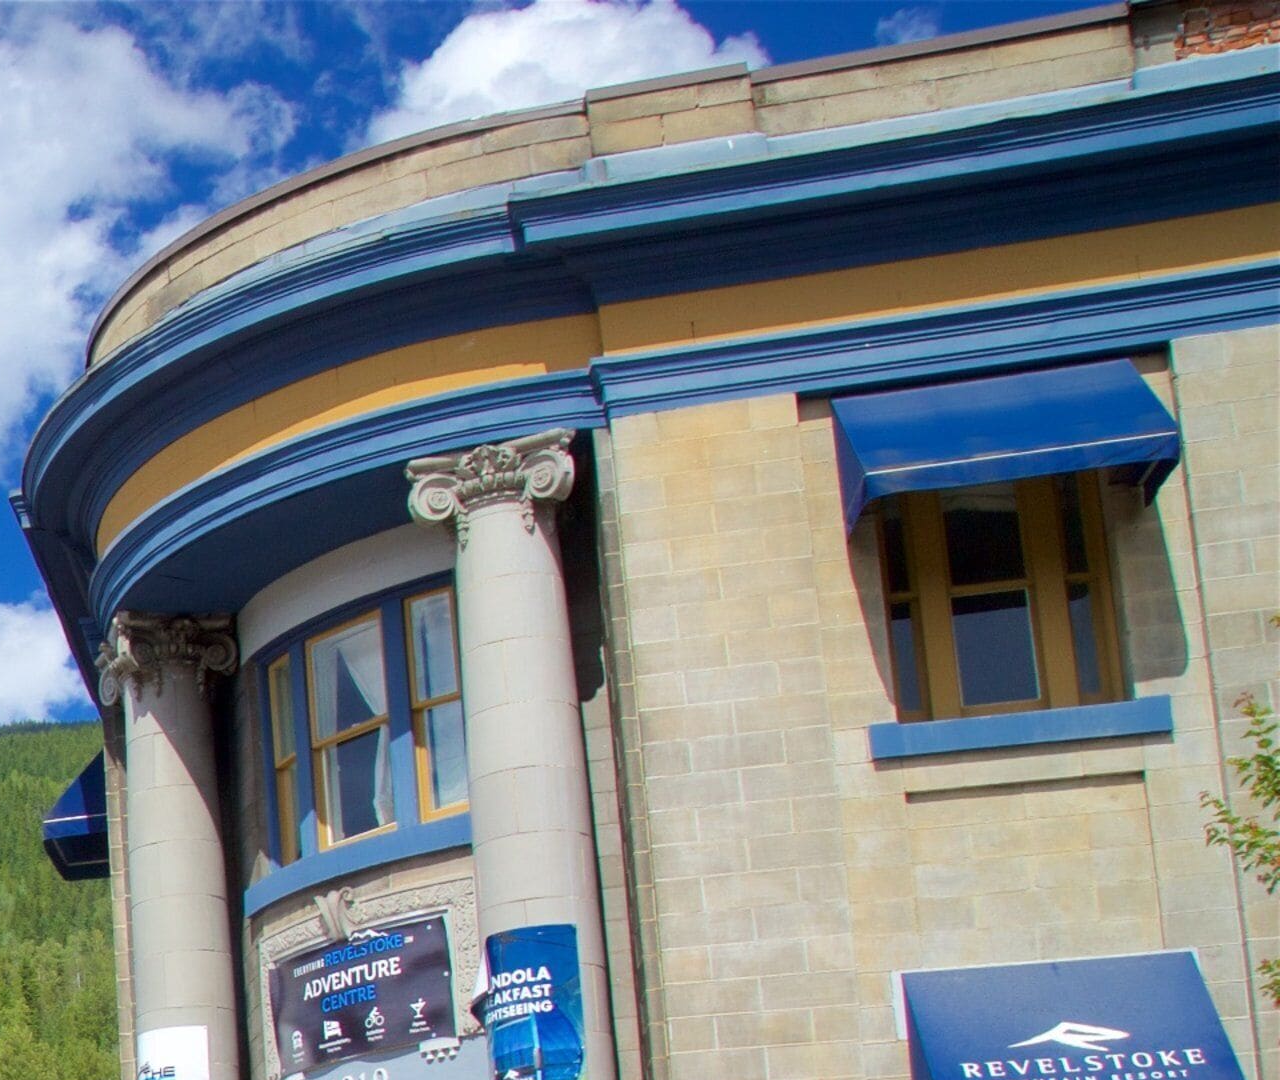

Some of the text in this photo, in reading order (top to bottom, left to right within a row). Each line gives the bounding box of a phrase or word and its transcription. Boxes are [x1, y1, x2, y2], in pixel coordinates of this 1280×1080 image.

[324, 933, 404, 968] REVELSTOKE
[303, 957, 402, 1001] ADVENTURE
[491, 966, 551, 990] NDOLA
[321, 984, 378, 1014] CENTRE
[959, 1048, 1206, 1080] REVELSTOKE
